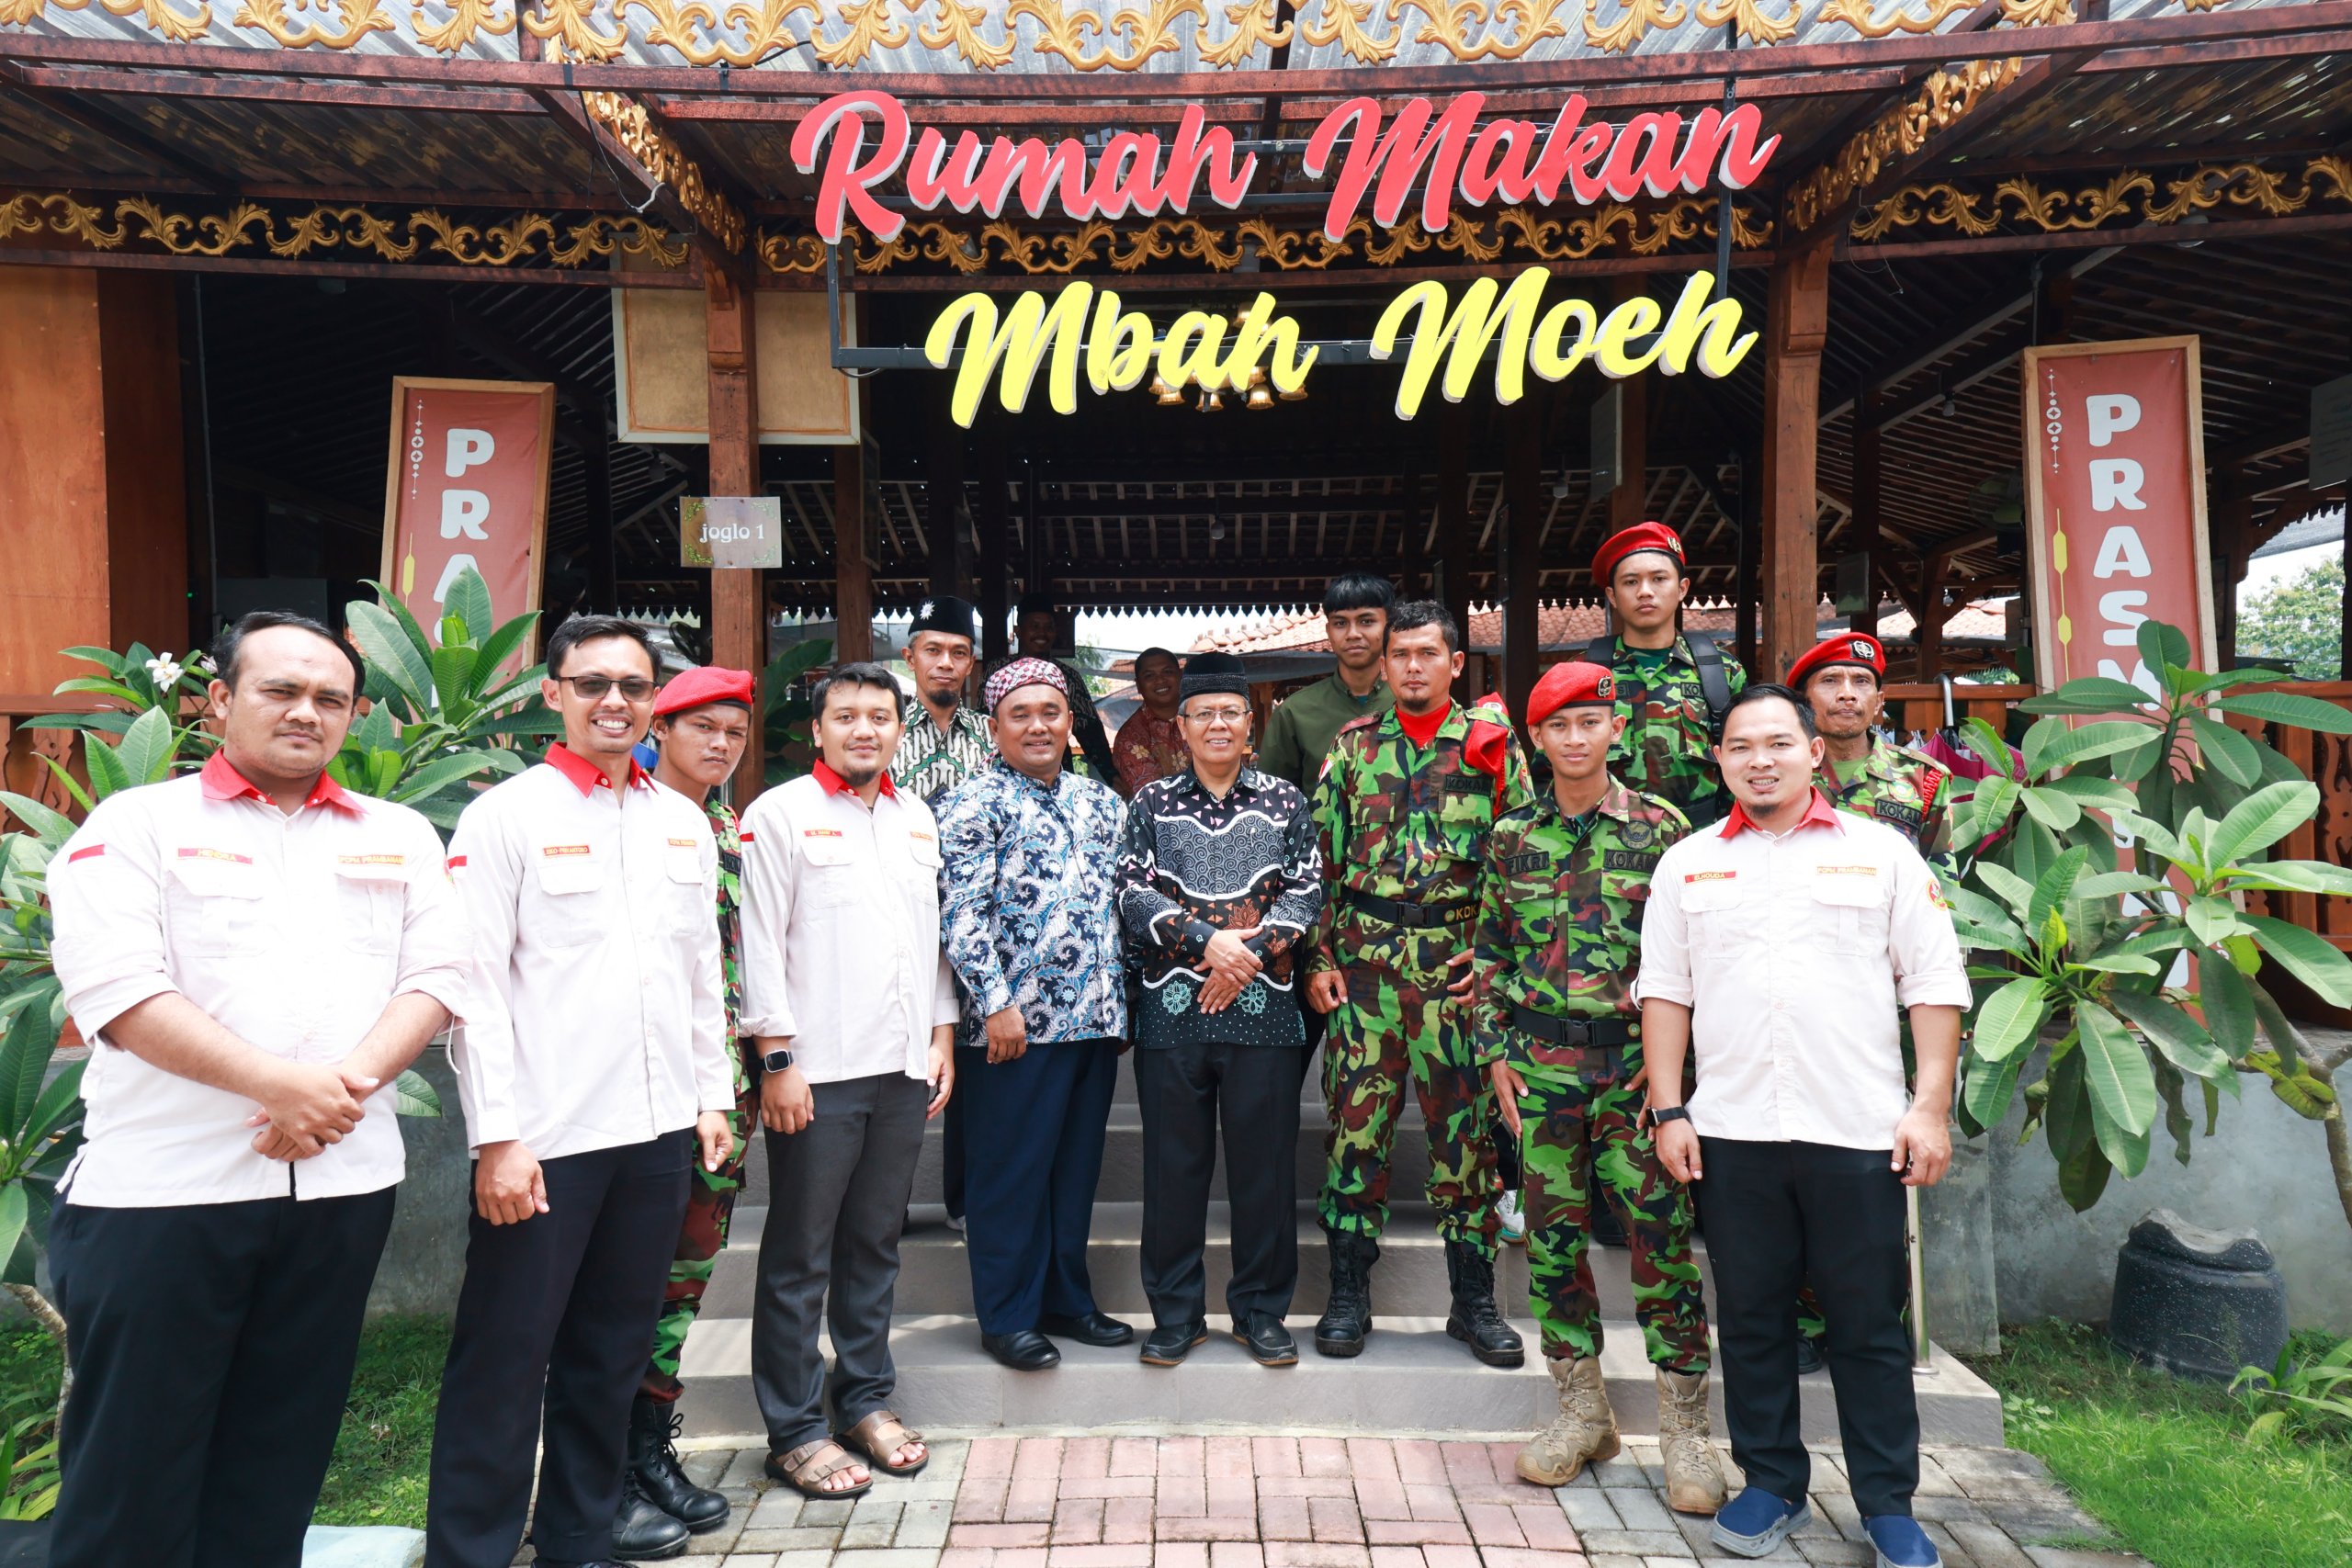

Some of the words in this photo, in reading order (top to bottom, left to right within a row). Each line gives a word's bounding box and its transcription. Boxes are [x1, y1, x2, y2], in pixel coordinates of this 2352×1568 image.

[790, 89, 1258, 244] Rumah
[1304, 90, 1781, 243] Makan
[924, 280, 1318, 428] Mbah
[1370, 266, 1758, 420] Moeh
[433, 428, 495, 644] PRA
[699, 524, 750, 543] joglo
[756, 524, 764, 539] 1
[1507, 853, 1548, 874] FIKRI
